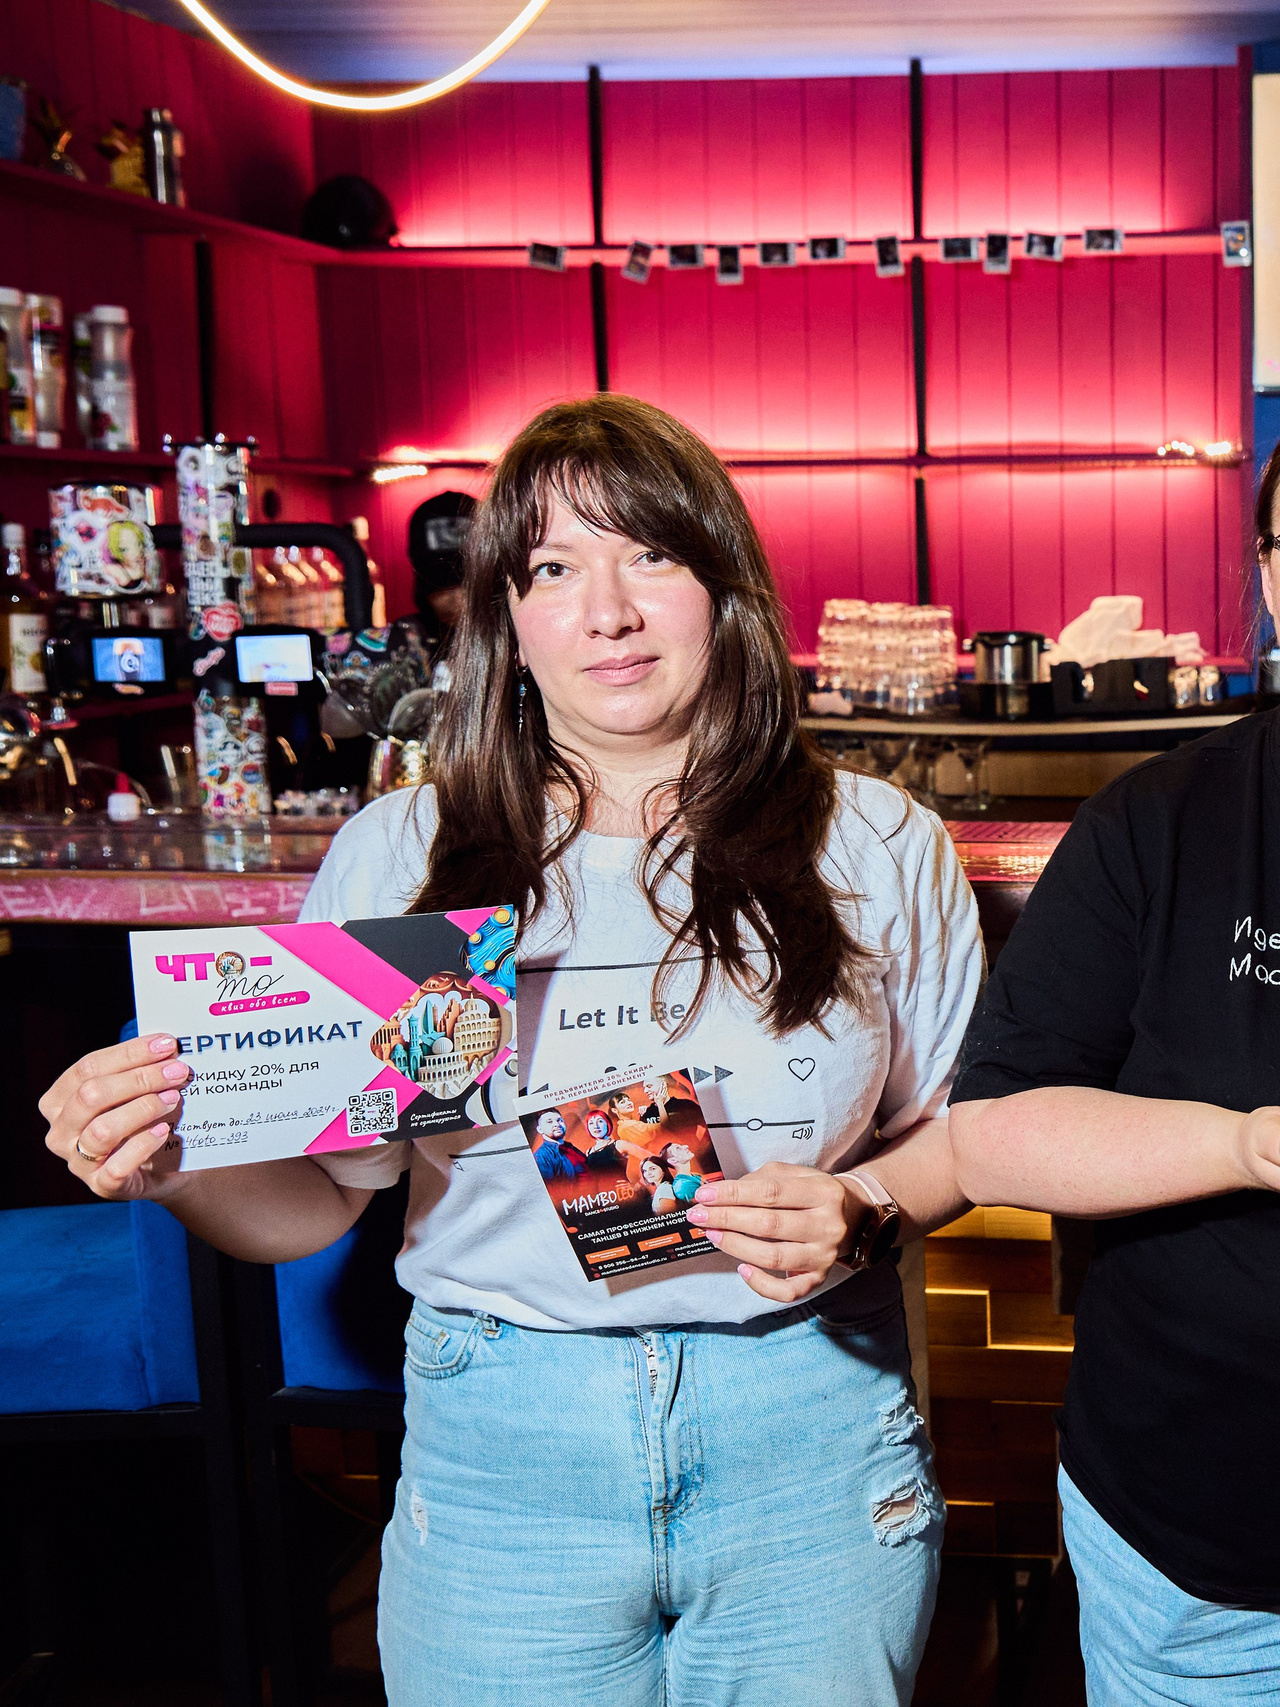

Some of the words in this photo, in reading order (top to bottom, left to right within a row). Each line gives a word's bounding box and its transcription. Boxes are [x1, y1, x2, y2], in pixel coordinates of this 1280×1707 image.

[220, 1002, 244, 1012] квиз
[249, 997, 267, 1008] обо
[271, 994, 297, 1005] всем
[559, 1008, 606, 1030] Let
[617, 1005, 639, 1025] It
[650, 1001, 686, 1022] Be
[179, 1020, 363, 1054] ЕРТИФИКАТ
[250, 1063, 285, 1077] 20%
[288, 1061, 320, 1075] для
[205, 1077, 283, 1095] команды
[543, 1078, 605, 1099] ПРЕДЪЯВИТЕЛЮ
[623, 1064, 654, 1076] СКИДКА
[568, 1087, 599, 1100] ПЕРВЫЙ
[601, 1072, 647, 1088] АБОНЕМЕНТ
[577, 1229, 606, 1241] САМАЯ
[591, 1233, 622, 1244] ТАНЦЕВ
[631, 1221, 665, 1235] НИЖНЕМ
